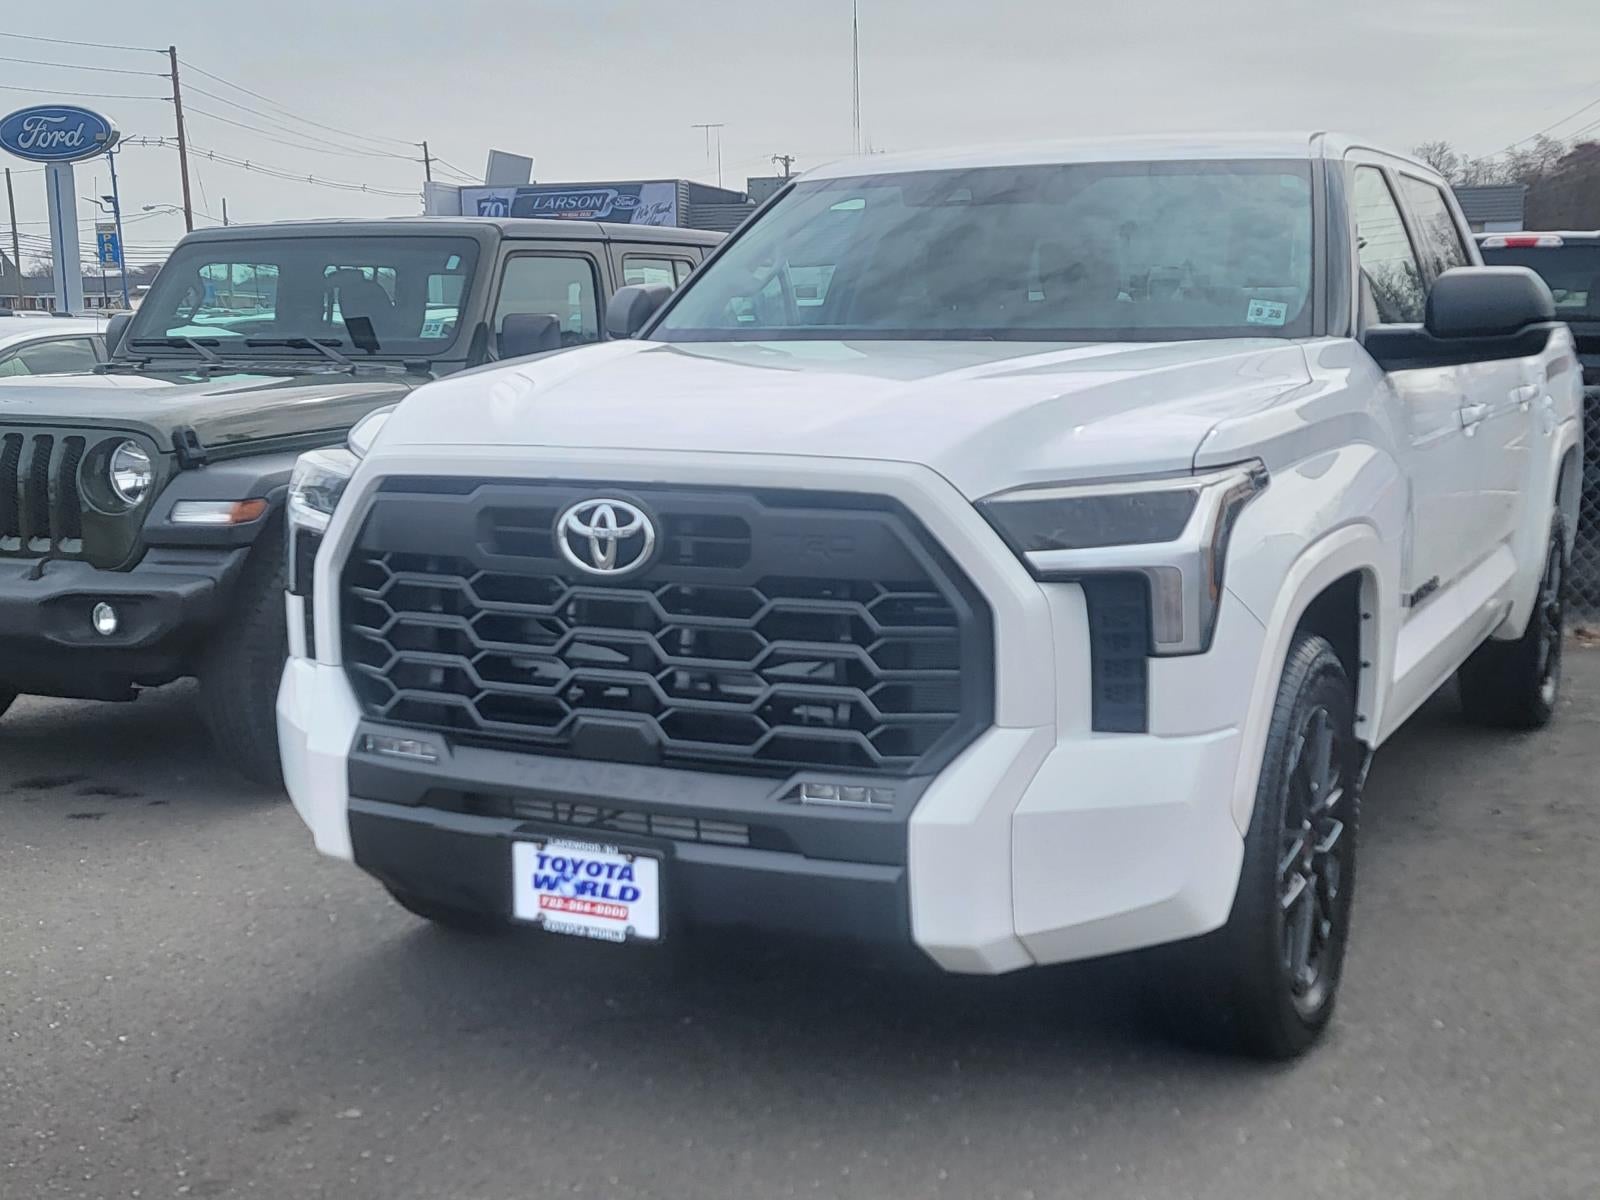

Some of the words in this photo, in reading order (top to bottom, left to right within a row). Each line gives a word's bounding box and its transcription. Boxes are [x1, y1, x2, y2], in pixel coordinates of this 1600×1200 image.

[18, 115, 84, 149] Ford
[532, 195, 604, 210] LARSON
[615, 196, 636, 206] Ford
[536, 854, 634, 881] TOYOTA
